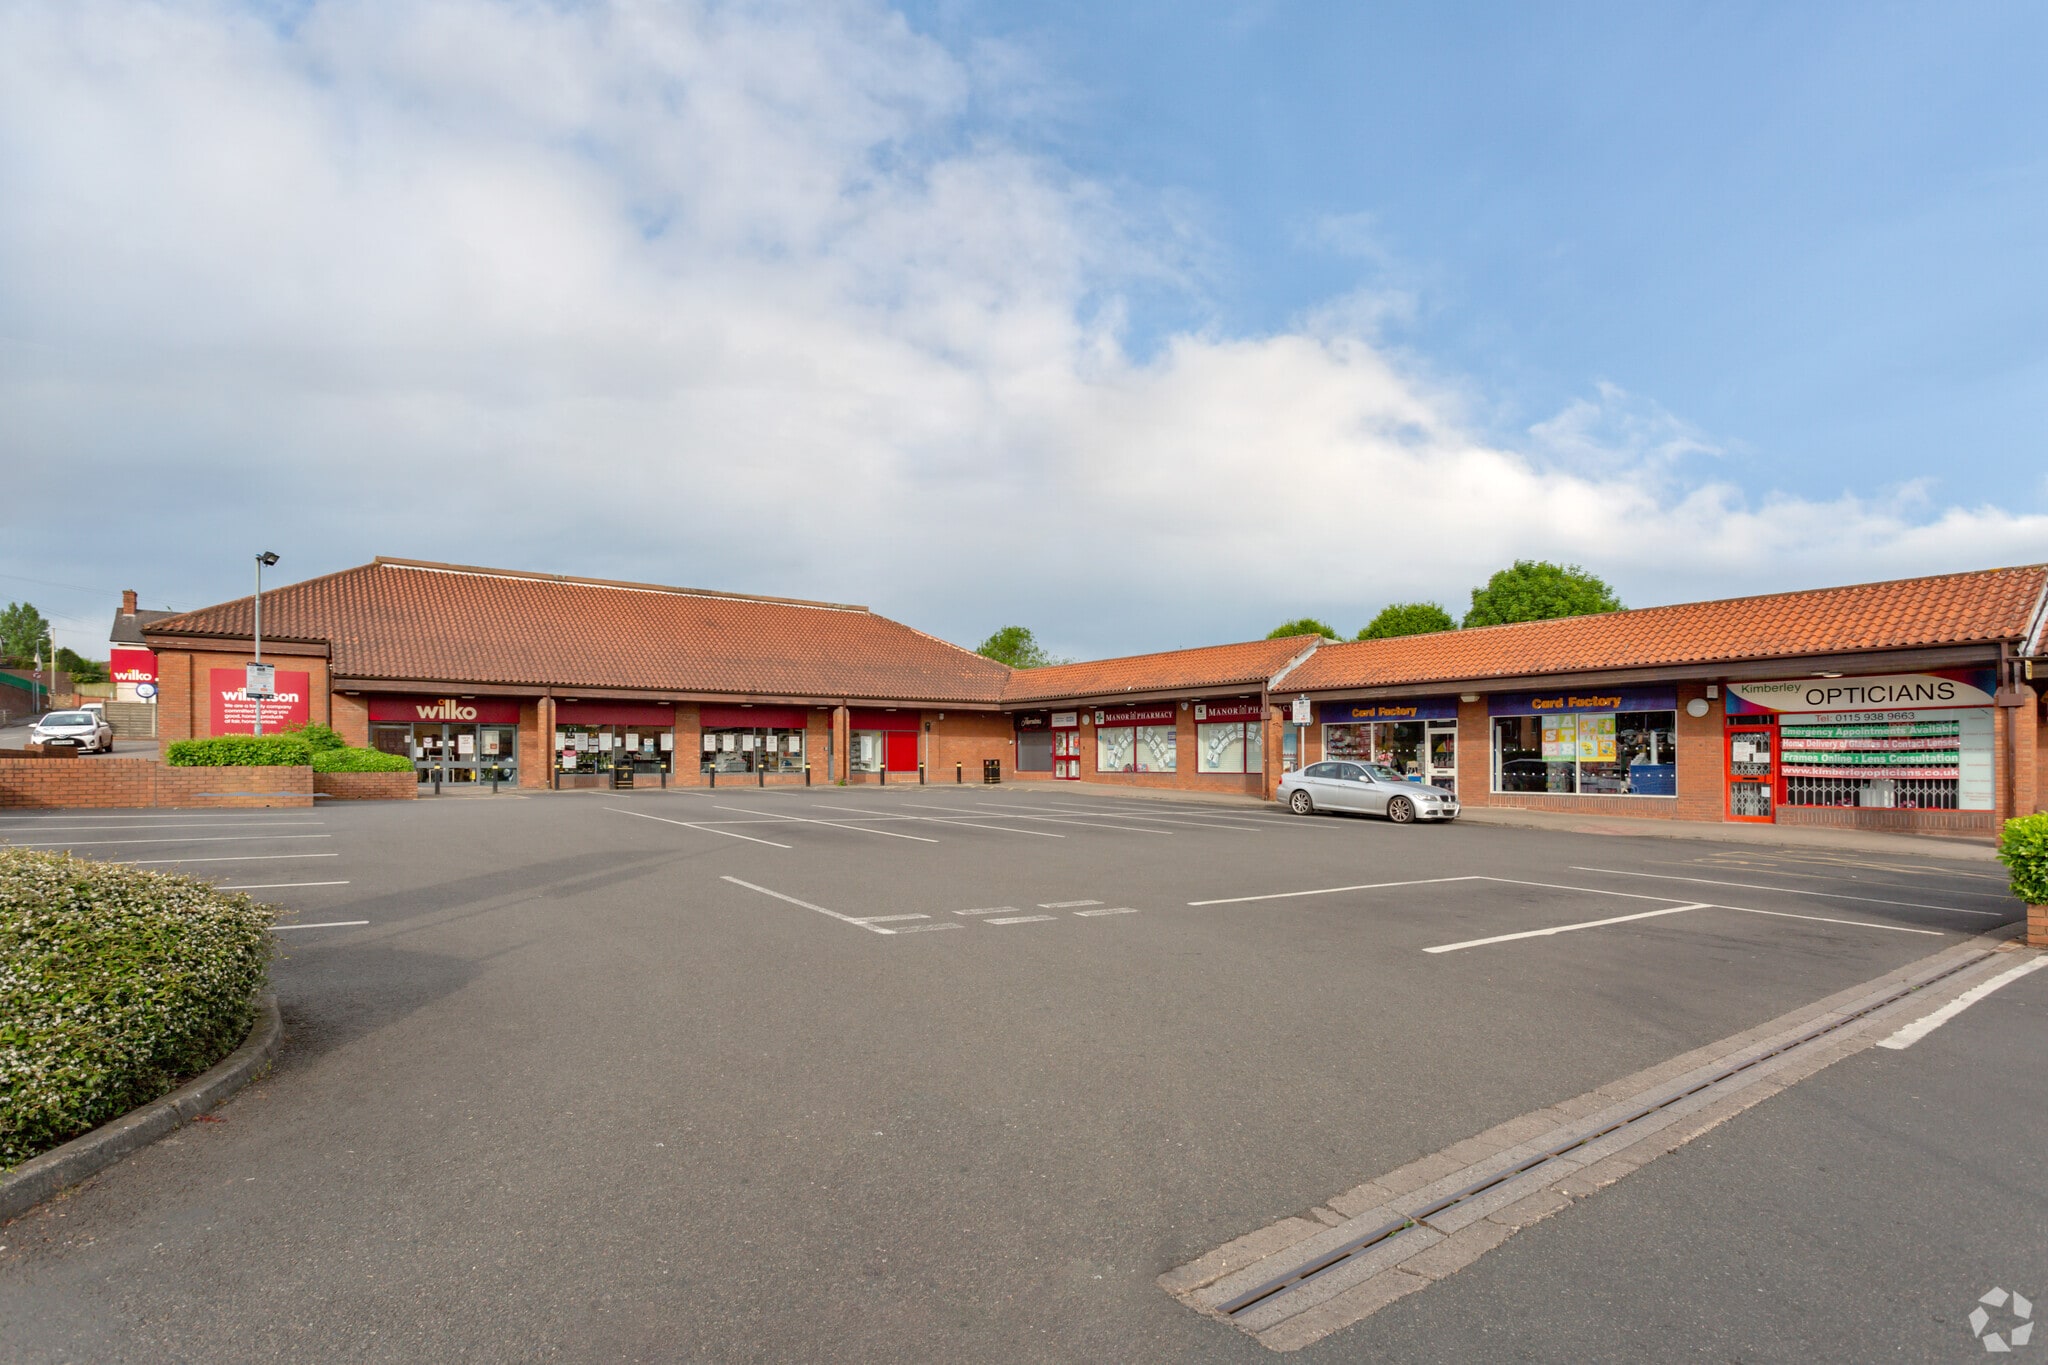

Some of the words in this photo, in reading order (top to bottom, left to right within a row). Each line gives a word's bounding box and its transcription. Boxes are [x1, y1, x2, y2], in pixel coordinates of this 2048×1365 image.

[114, 669, 152, 681] wilko
[1742, 683, 1802, 695] Kimberley
[1806, 682, 1955, 706] OPTICIANS
[1532, 697, 1563, 709] Card
[1568, 695, 1622, 709] Factory
[416, 699, 477, 720] wilko
[1208, 707, 1238, 717] MANOR
[1352, 707, 1375, 718] Card
[1378, 706, 1417, 717] Factory
[1106, 713, 1130, 721] MANOR
[1137, 711, 1173, 720] PHARMACY
[1815, 714, 1833, 723] Tel:
[1835, 713, 1860, 722] 0115
[1864, 713, 1884, 721] 938
[1887, 712, 1915, 720] 9663
[1781, 727, 1833, 737] Emergency
[1835, 727, 1906, 737] Appointments
[1908, 723, 1959, 734] Available
[1782, 739, 1804, 748] Home
[1806, 739, 1838, 749] Delivery
[1840, 739, 1849, 748] of
[1850, 739, 1881, 748] Glasses
[1882, 740, 1889, 748] &
[1891, 739, 1924, 748] Contact
[1927, 737, 1958, 747] Lenses
[1783, 752, 1818, 762] Frames
[1820, 753, 1852, 763] Online
[1861, 754, 1886, 763] Lens
[1889, 753, 1958, 763] Consultation
[1782, 767, 1958, 778] www.kimberleyopticians.co.uk
